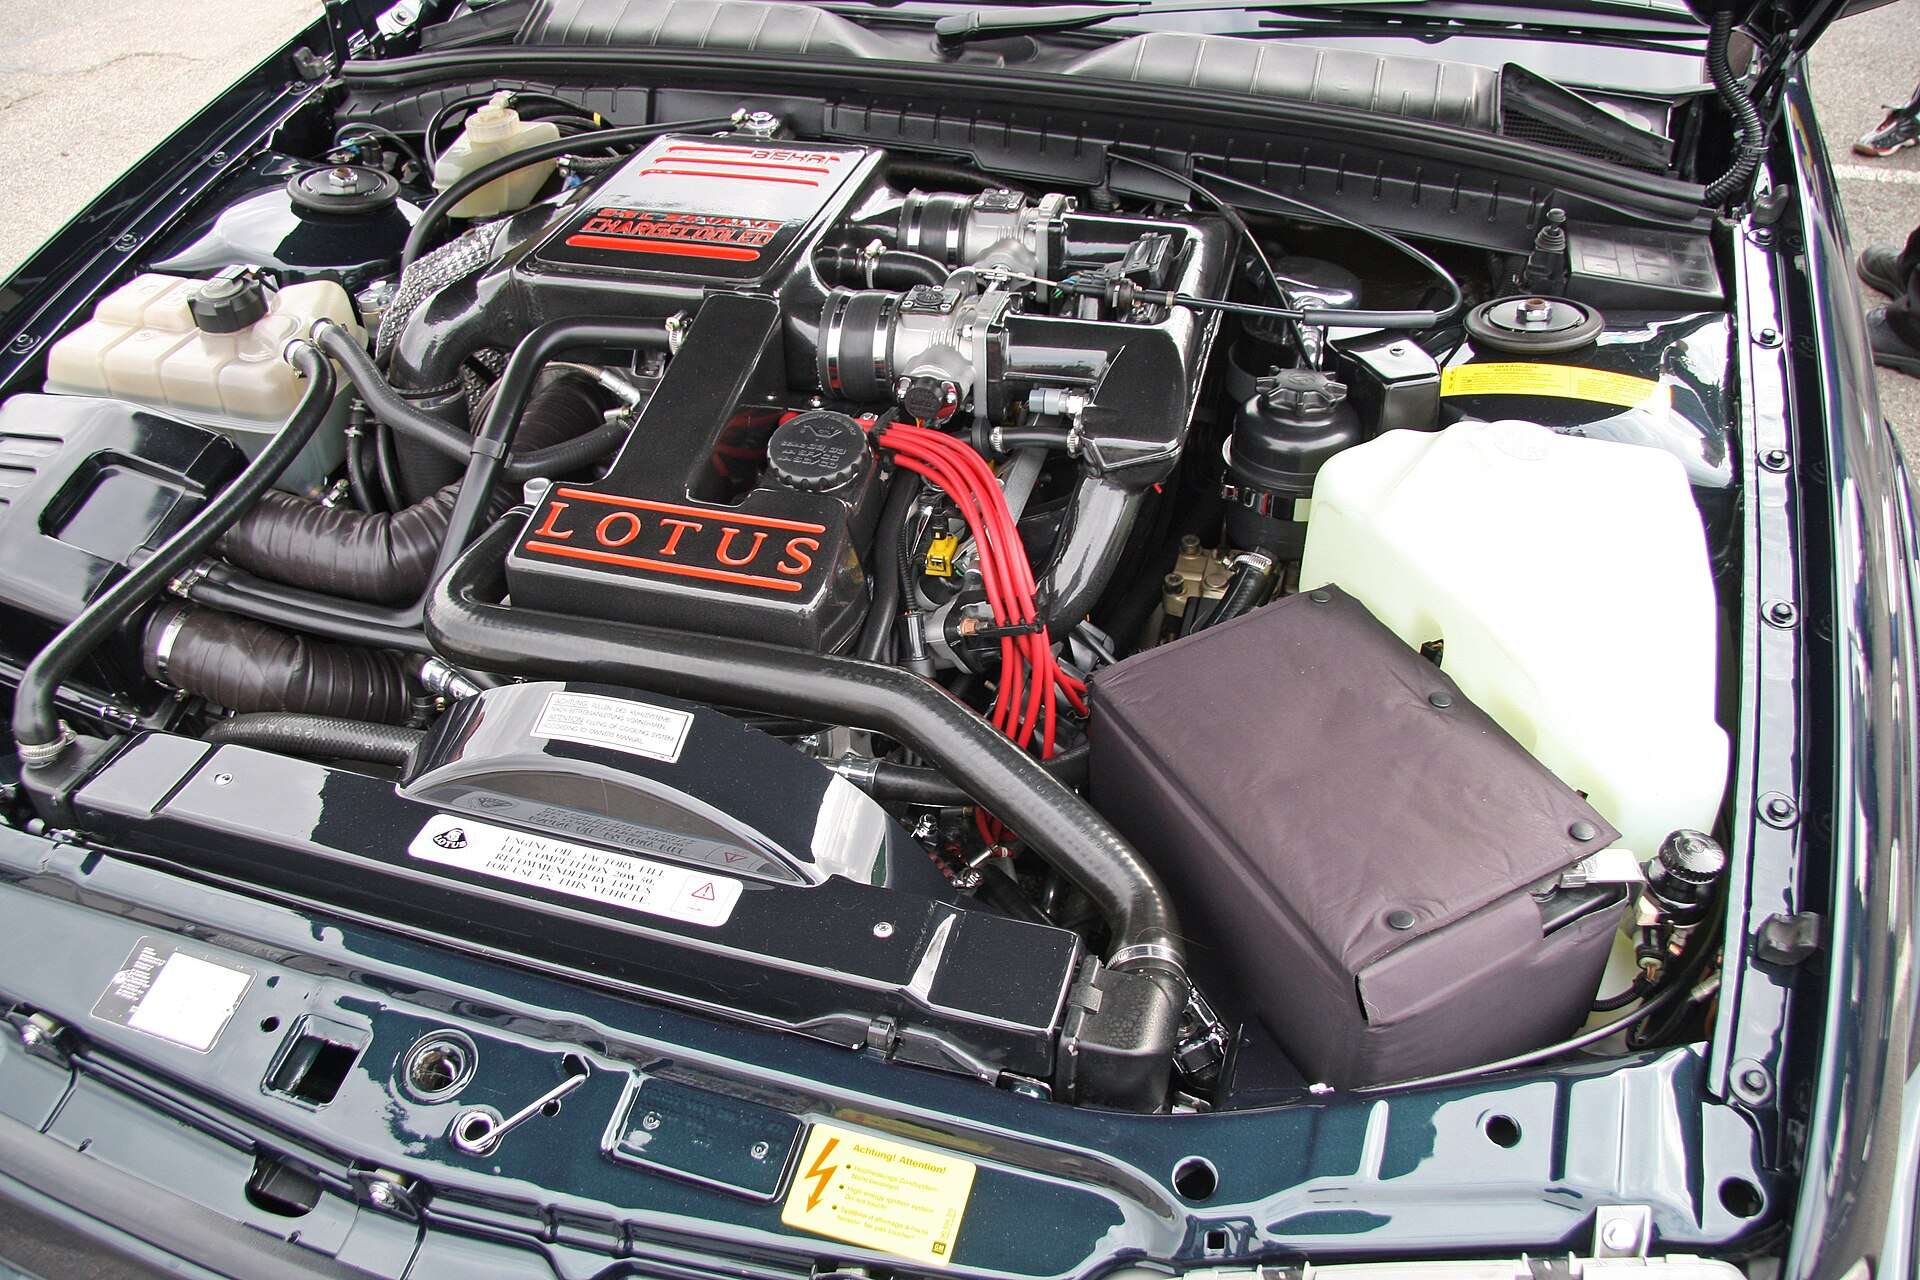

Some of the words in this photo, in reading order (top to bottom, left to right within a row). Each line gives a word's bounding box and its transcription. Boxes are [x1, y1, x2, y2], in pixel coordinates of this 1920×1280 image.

[580, 218, 775, 245] CHARGECOOLED
[534, 501, 820, 575] LOTUS
[433, 834, 467, 849] LOTUS
[504, 836, 547, 849] ENGINE
[581, 852, 633, 869] FACTORY
[495, 852, 588, 879] RECOMMENDED
[590, 875, 606, 883] BY
[611, 880, 652, 894] LOTUS
[499, 844, 523, 853] ELF
[527, 849, 609, 874] COMPETITION
[485, 861, 509, 870] FOR
[511, 866, 533, 876] USE
[538, 873, 553, 881] IN
[559, 878, 587, 889] THIS
[852, 1144, 896, 1162] Achtung!
[899, 1155, 946, 1173] Attention!
